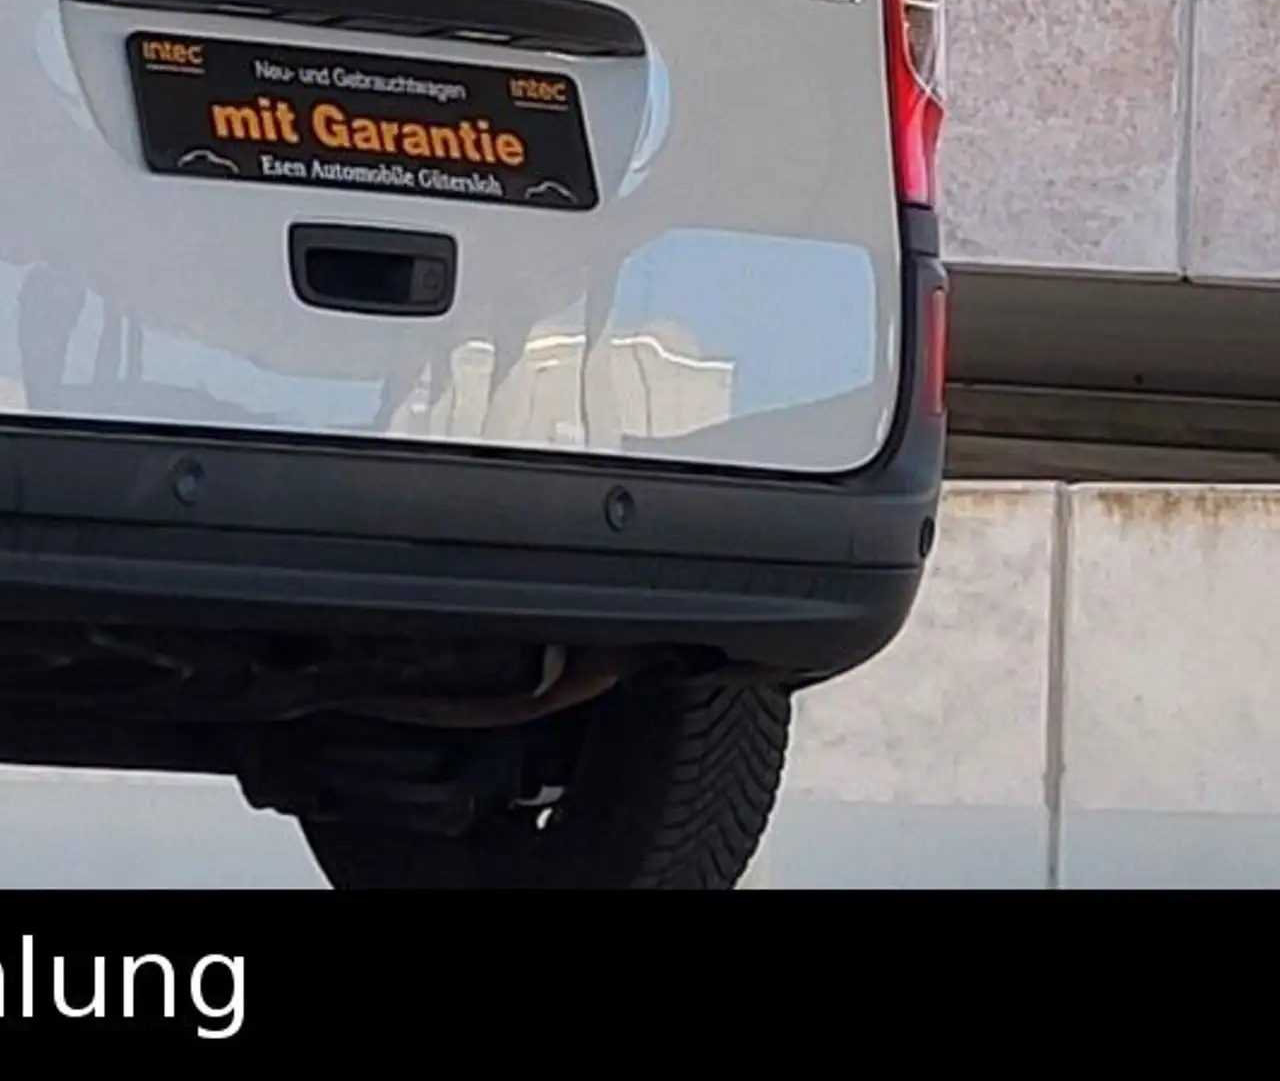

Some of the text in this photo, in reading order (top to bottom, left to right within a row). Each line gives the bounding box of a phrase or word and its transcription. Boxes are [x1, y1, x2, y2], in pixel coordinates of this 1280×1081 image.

[255, 60, 466, 103] Neu- und Gebrauchtwagen
[212, 97, 525, 166] mit Garantie
[260, 155, 307, 177] Esen
[310, 160, 415, 188] Automobile
